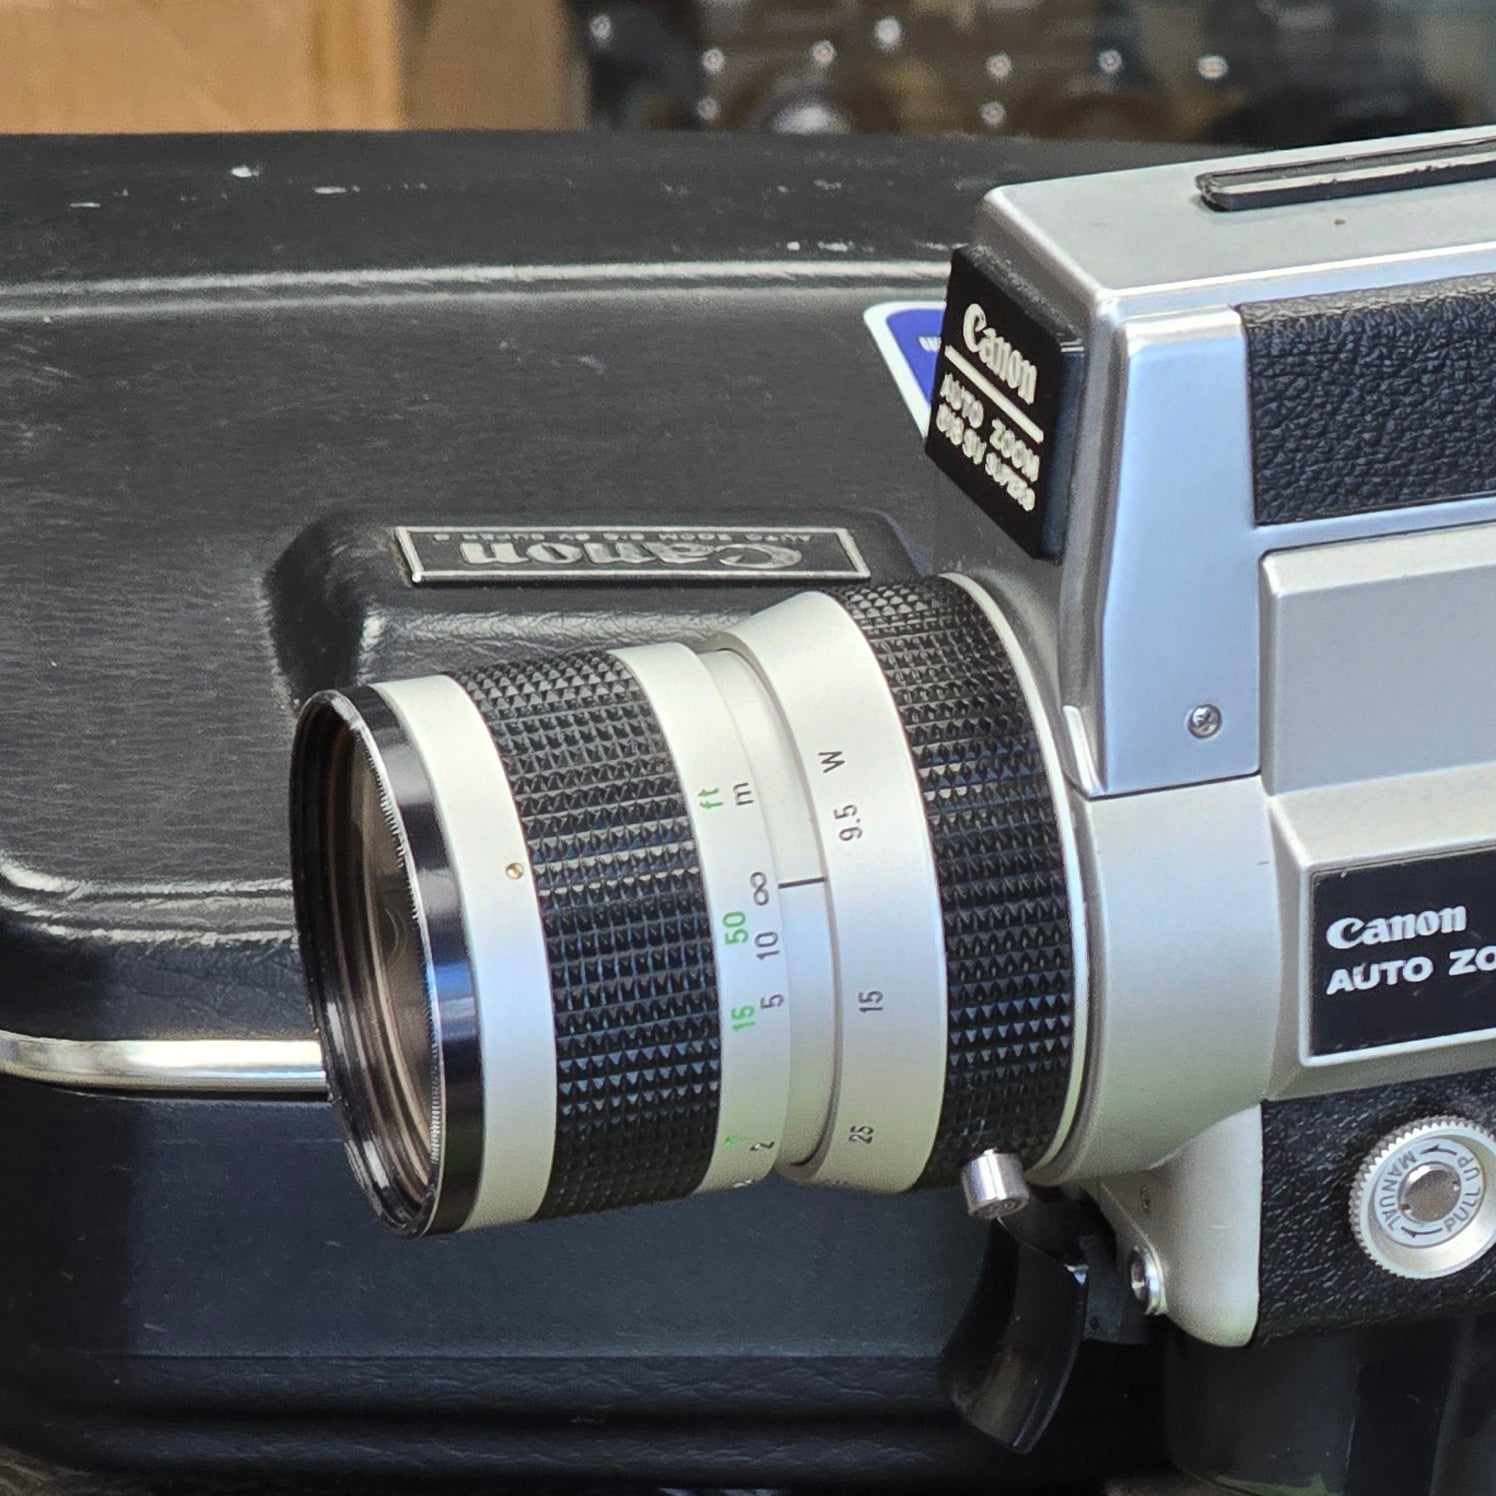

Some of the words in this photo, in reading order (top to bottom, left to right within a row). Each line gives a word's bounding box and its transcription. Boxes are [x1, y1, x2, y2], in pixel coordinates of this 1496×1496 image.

[962, 303, 1038, 405] Canon
[458, 541, 803, 569] Canon
[818, 750, 846, 774] W
[698, 787, 724, 811] ft
[732, 782, 755, 806] m
[833, 804, 863, 842] 9.5
[722, 911, 749, 946] 50
[1325, 905, 1468, 950] Canon
[754, 931, 780, 961] 10
[1326, 956, 1435, 995] AUTO
[759, 994, 785, 1010] 5
[858, 990, 884, 1013] 15
[730, 1004, 756, 1032] 15
[1457, 1155, 1481, 1182] UP
[1378, 1150, 1417, 1232] MANUAL
[1443, 1186, 1482, 1233] PULL
